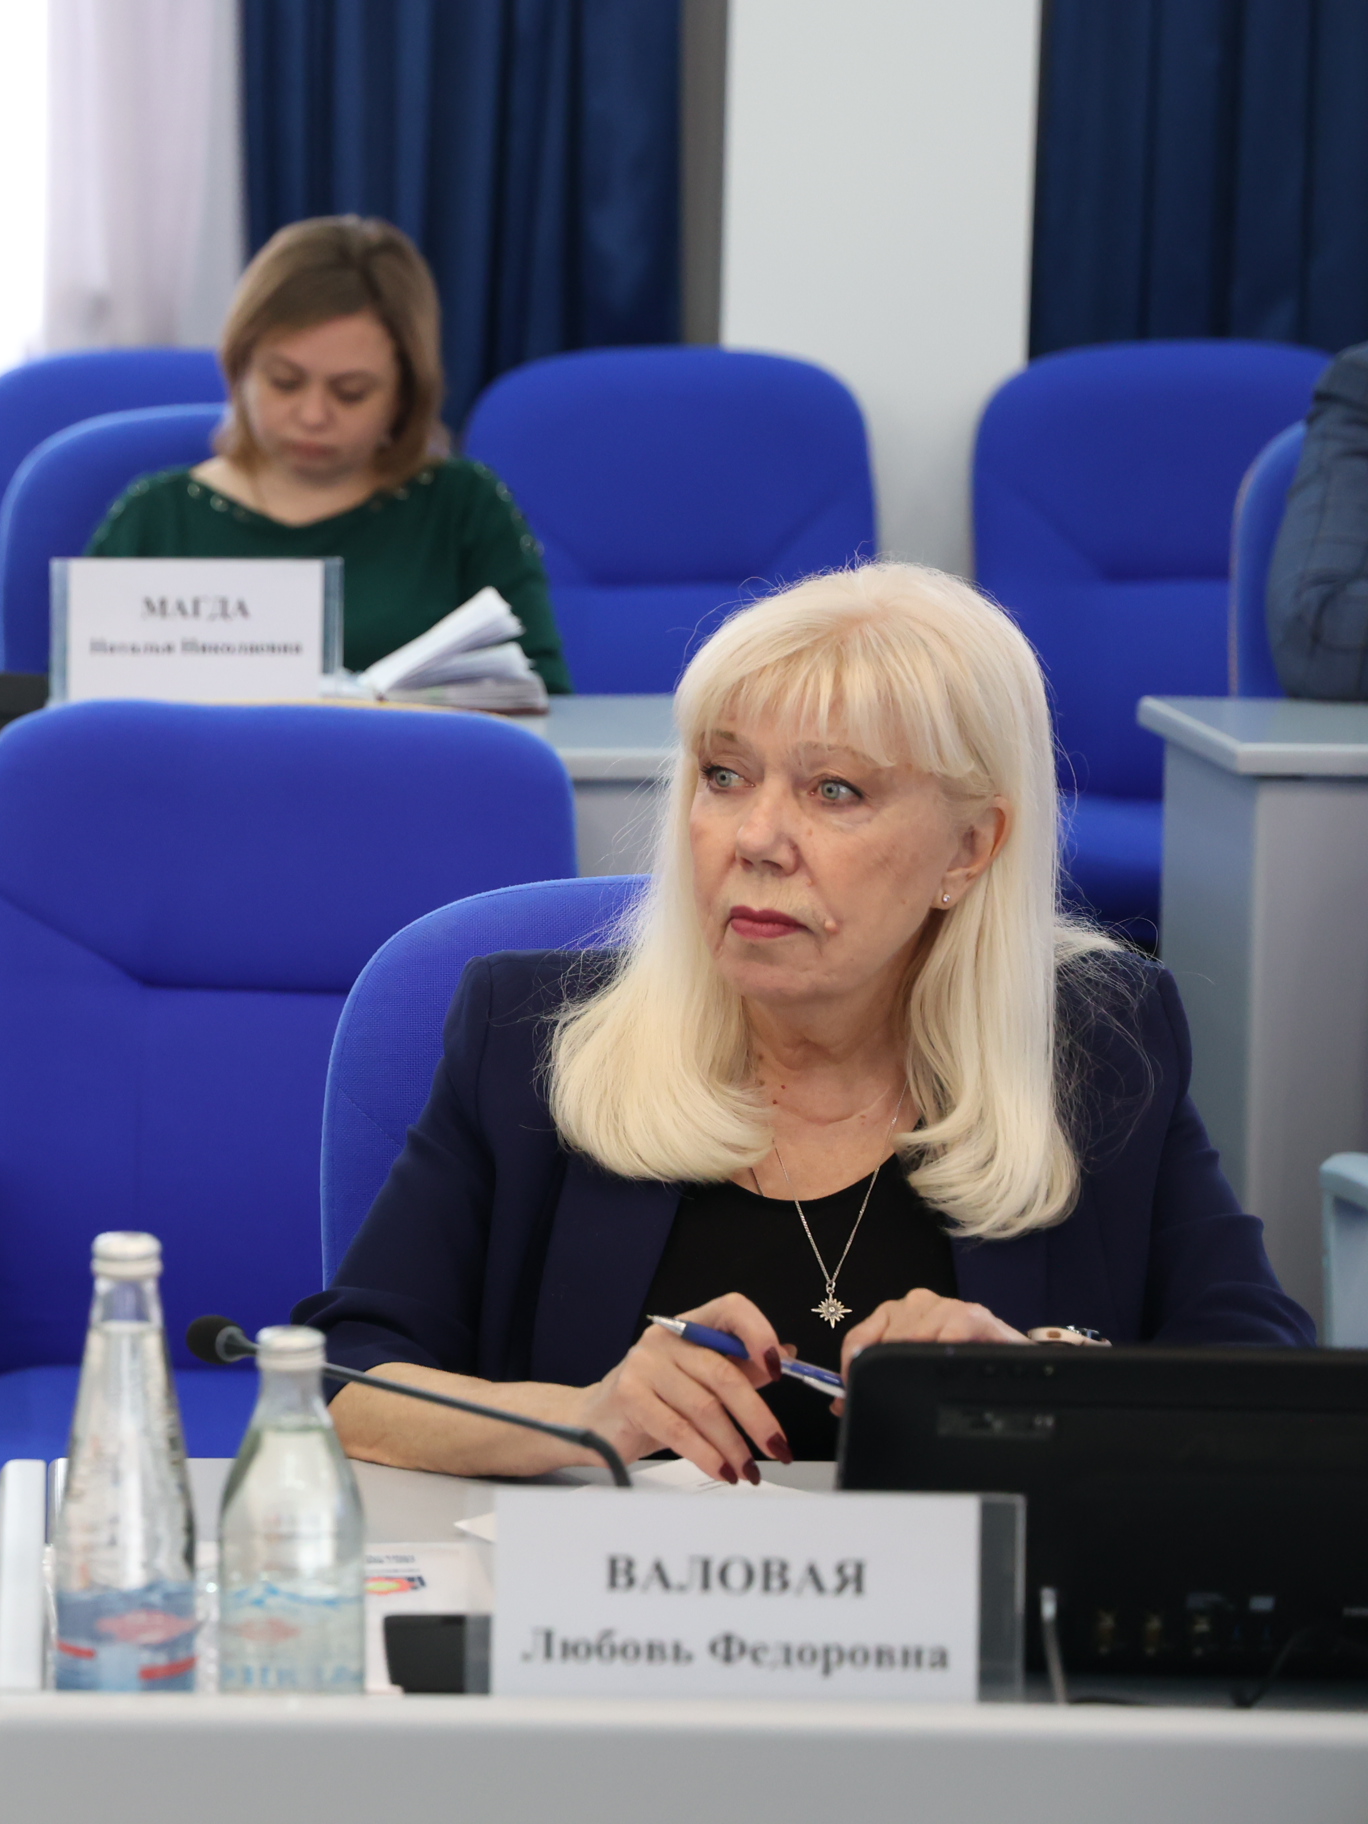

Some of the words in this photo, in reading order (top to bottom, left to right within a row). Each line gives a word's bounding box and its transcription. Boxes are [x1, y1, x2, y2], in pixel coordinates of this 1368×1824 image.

[142, 597, 252, 622] МАГДА
[608, 1555, 867, 1598] ВАЛОВАЯ
[522, 1628, 695, 1666] Любовь
[708, 1632, 951, 1680] Федоровна
